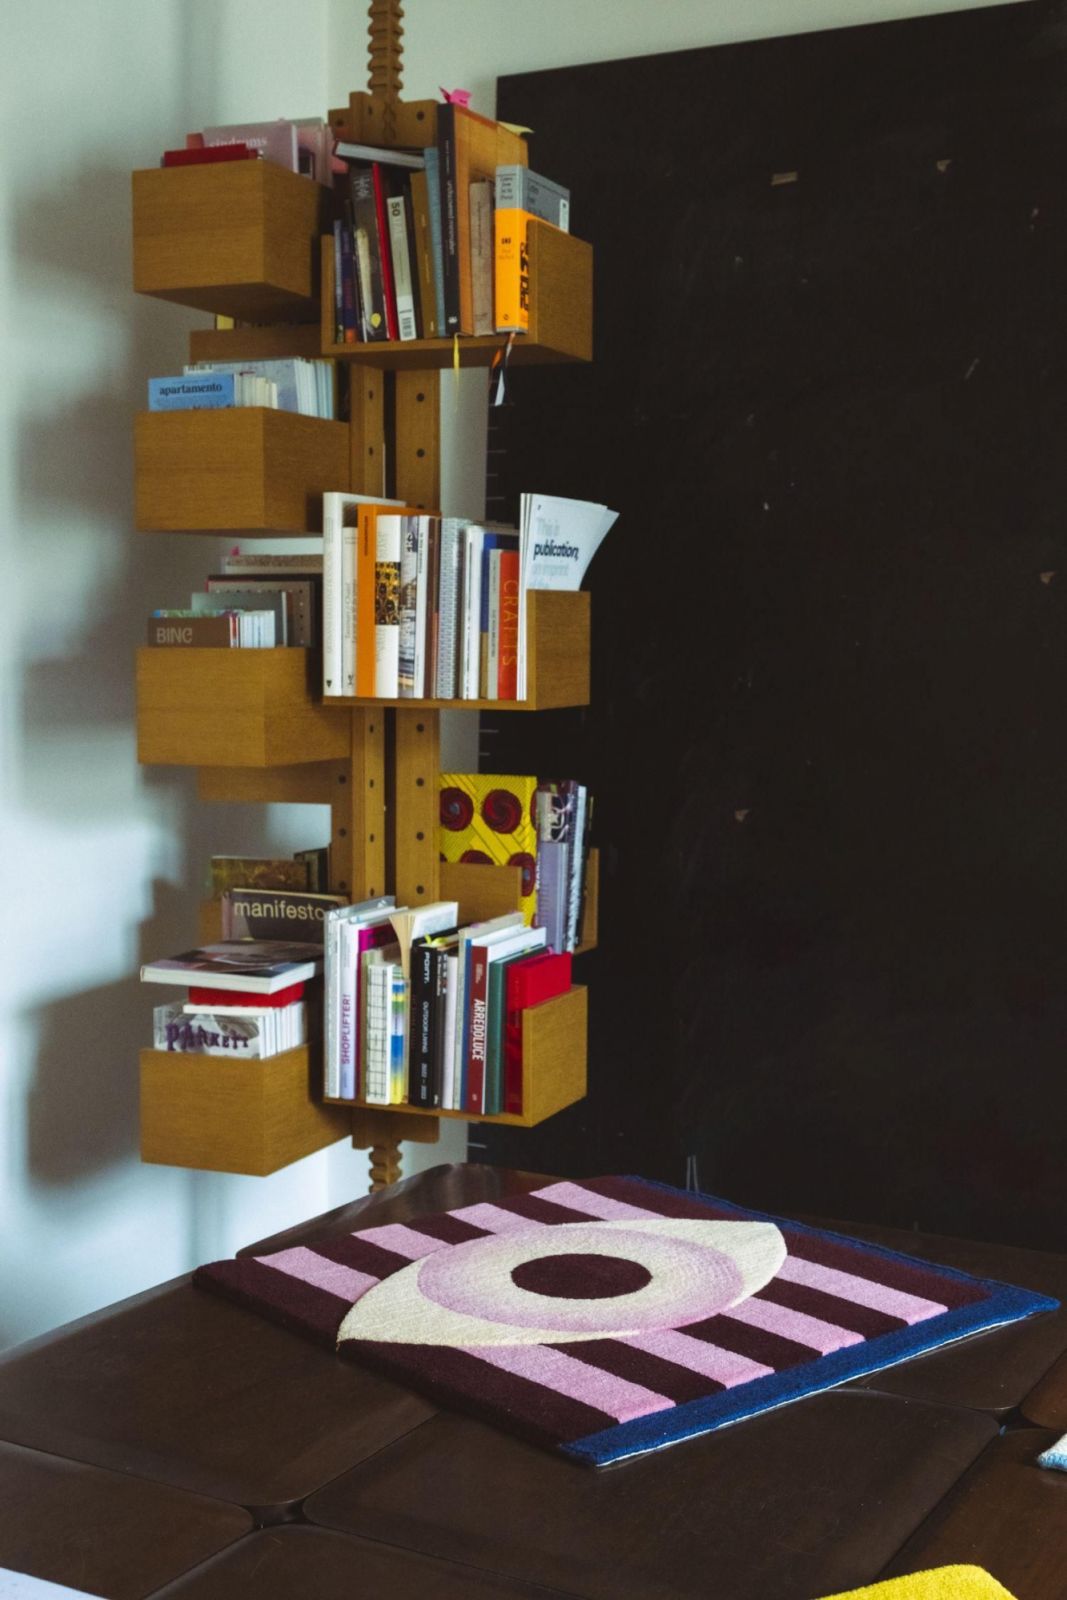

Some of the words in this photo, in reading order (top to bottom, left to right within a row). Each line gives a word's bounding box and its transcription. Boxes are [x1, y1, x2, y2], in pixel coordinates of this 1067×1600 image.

[159, 381, 223, 398] apartamento
[502, 580, 518, 667] CRAFTS
[234, 899, 325, 922] manifesto
[165, 1022, 249, 1053] PARKETT
[341, 994, 351, 1065] SHOPLIFTER!
[471, 998, 486, 1061] ARREDOLUCE
